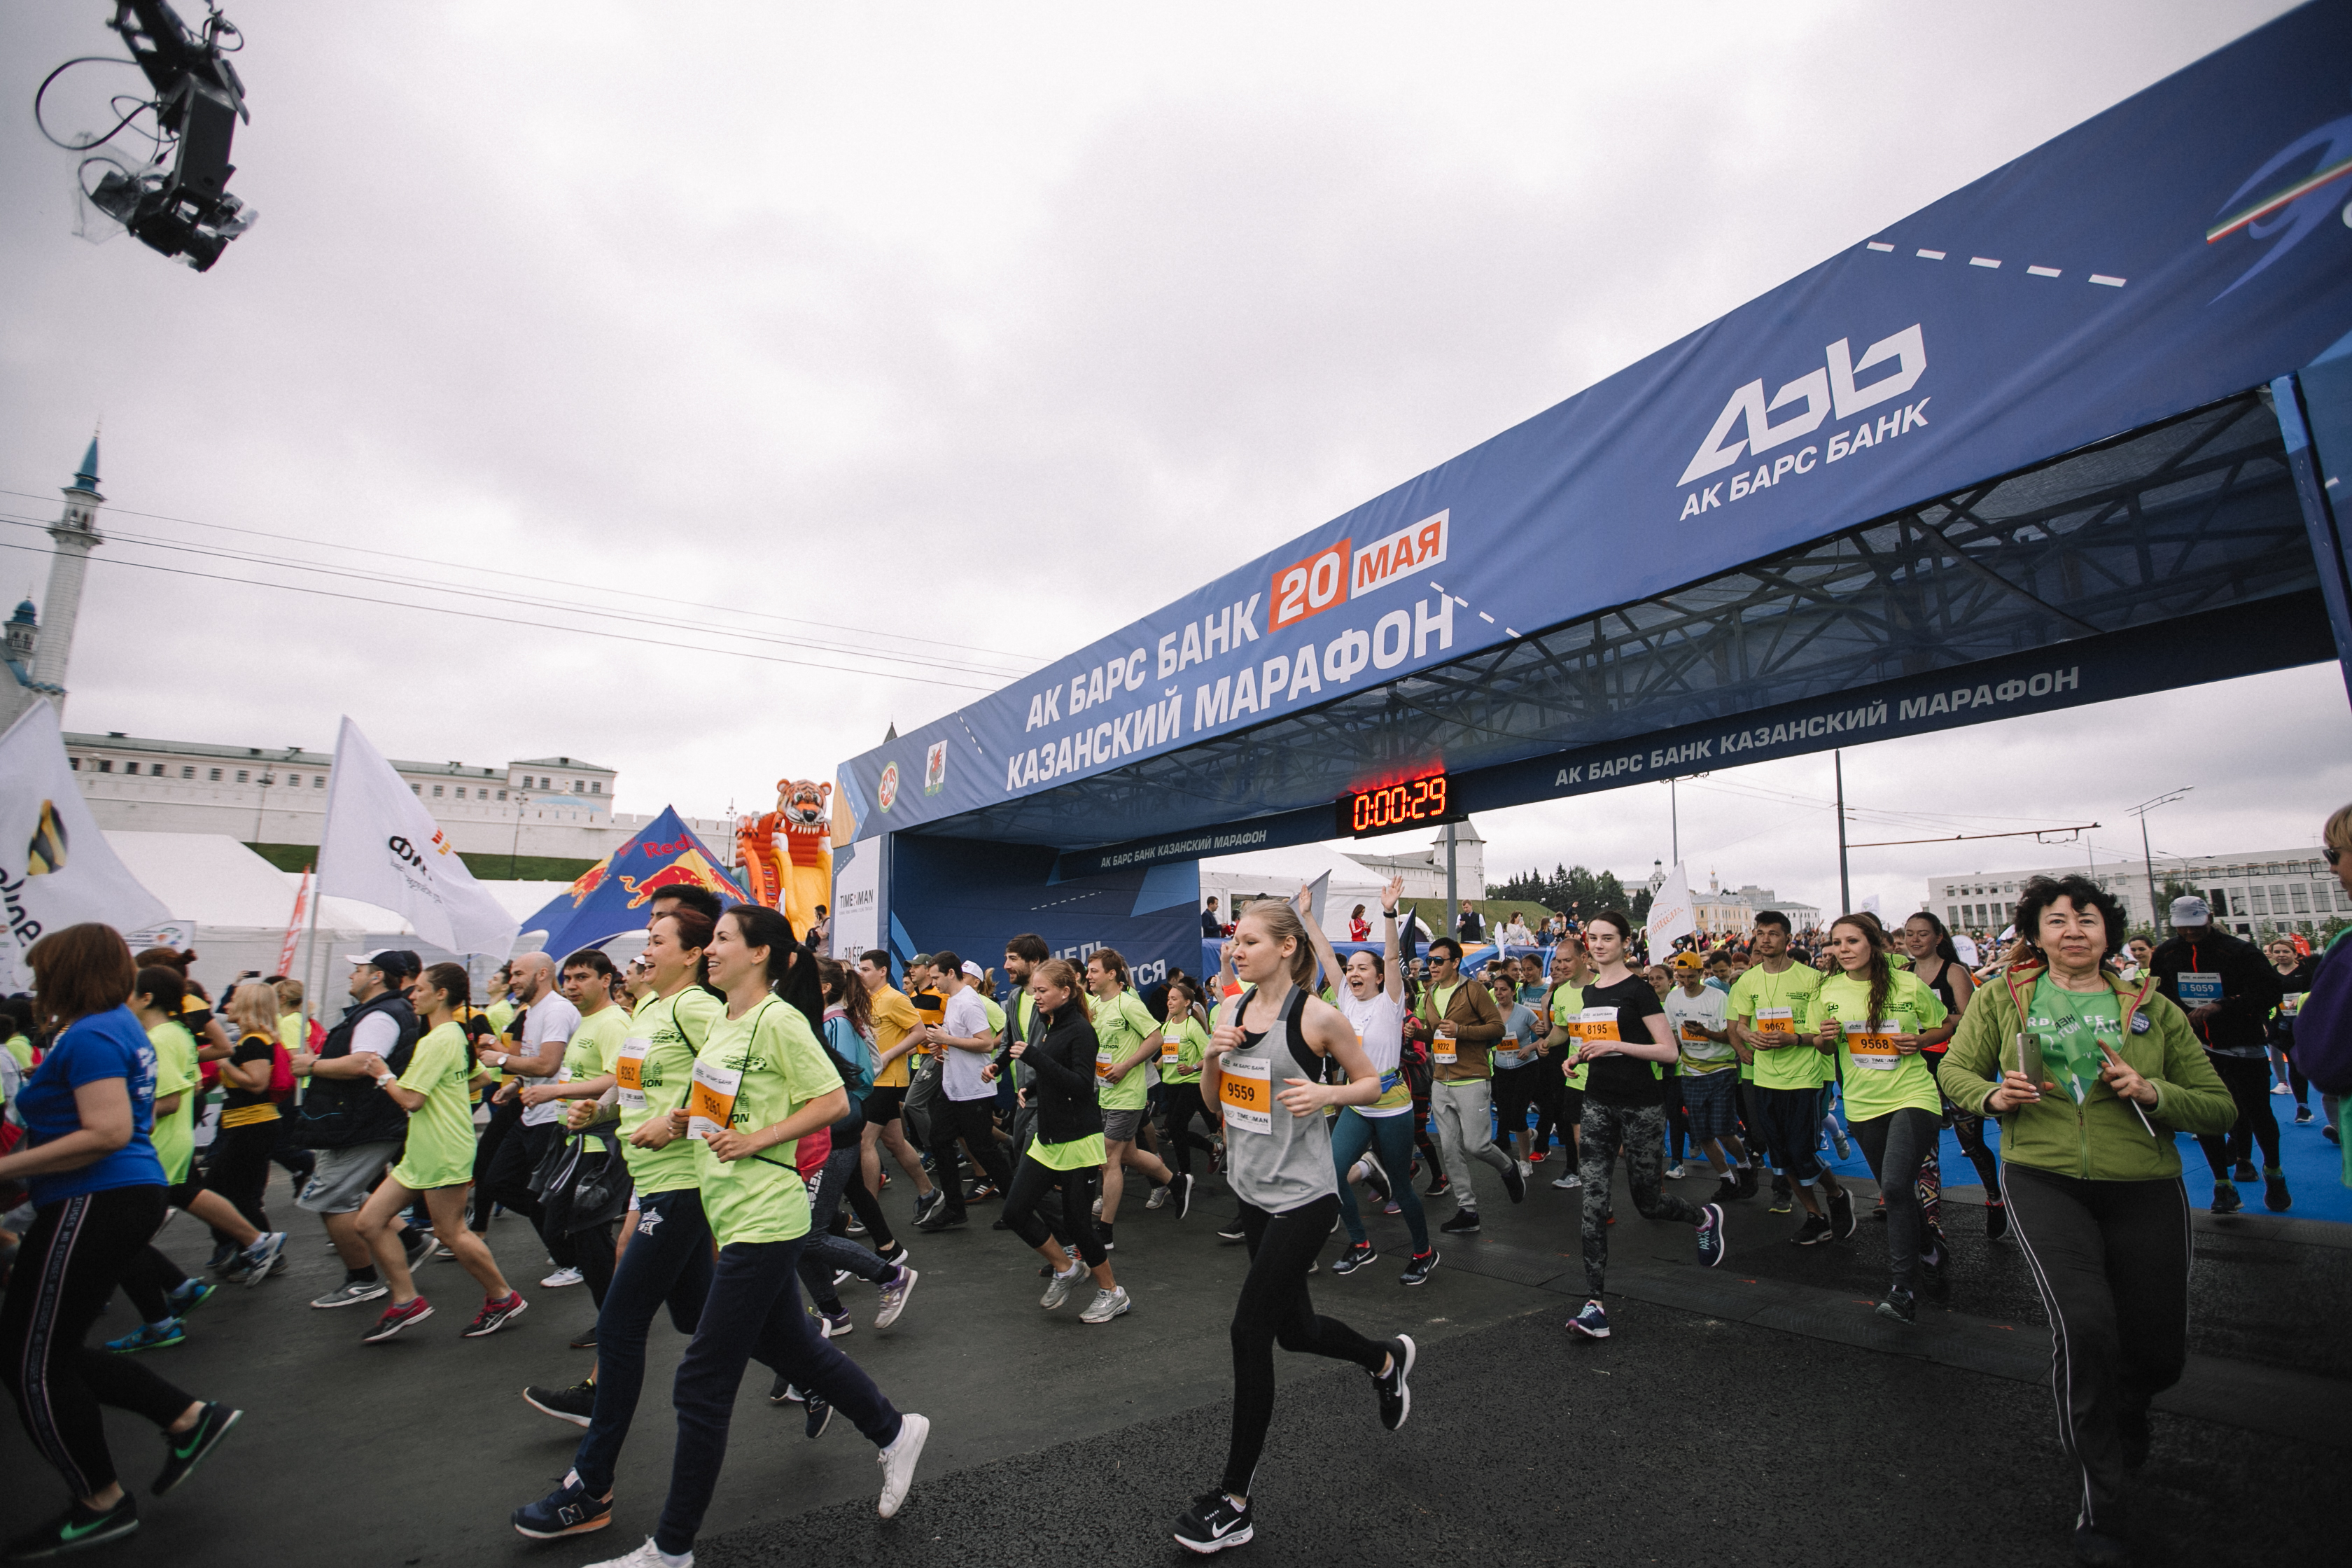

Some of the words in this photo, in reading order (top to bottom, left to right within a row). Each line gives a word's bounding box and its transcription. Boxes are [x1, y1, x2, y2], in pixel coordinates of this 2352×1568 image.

[1680, 482, 1723, 521] АК
[1729, 446, 1817, 502] БАРС
[1826, 396, 1931, 464] БАНК
[1026, 684, 1063, 732] АК
[1068, 648, 1147, 716] БАРС
[1157, 592, 1261, 681] БАНК
[1278, 552, 1341, 625] 20
[1357, 521, 1441, 589] МАЯ
[1006, 688, 1183, 791] КАЗАНСКИЙ
[1194, 594, 1454, 732] МАРАФОН
[1554, 766, 1582, 788] АК
[1588, 755, 1643, 781] БАРС
[1650, 738, 1712, 769] БАНК
[1720, 699, 1887, 755] КАЗАНСКИЙ
[1899, 666, 2079, 721] МАРАФОН
[1353, 776, 1446, 832] 0:00:29
[642, 833, 690, 858] Red
[1101, 858, 1111, 868] АК
[1113, 853, 1132, 866] БАРС
[1134, 847, 1155, 862] БАНК
[1158, 835, 1211, 857] КАЗАНСКИЙ
[1214, 830, 1267, 848] МАРАФОН
[2190, 984, 2214, 993] 5059
[1588, 1023, 1607, 1035] 8195
[1765, 1022, 1786, 1031] 9062
[1861, 1039, 1889, 1049] 9568
[1227, 1082, 1255, 1102] 9559
